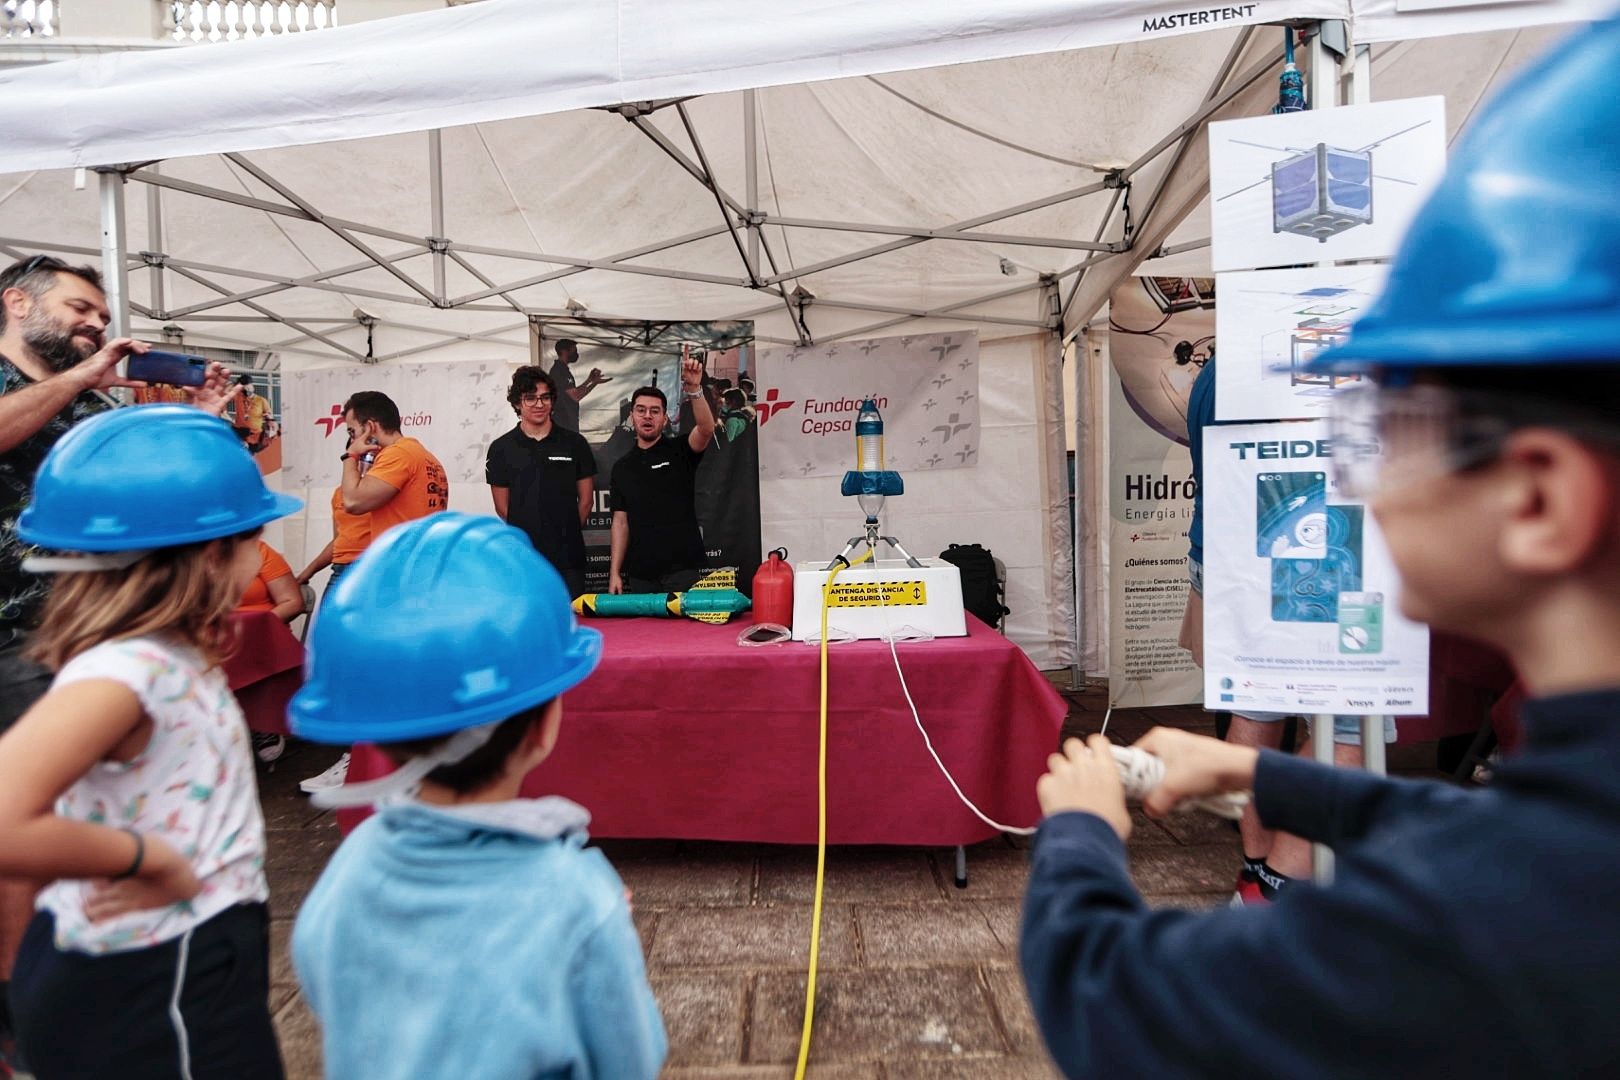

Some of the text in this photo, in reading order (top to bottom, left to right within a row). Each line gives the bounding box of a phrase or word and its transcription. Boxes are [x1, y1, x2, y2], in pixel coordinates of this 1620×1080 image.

[1142, 4, 1257, 32] MASTERTENT
[801, 418, 852, 437] Cepsa
[1230, 440, 1335, 460] TEIDE
[1125, 474, 1196, 500] Hidró
[1125, 508, 1176, 521] Energía
[1125, 557, 1188, 567] ¿Quiénes somos?
